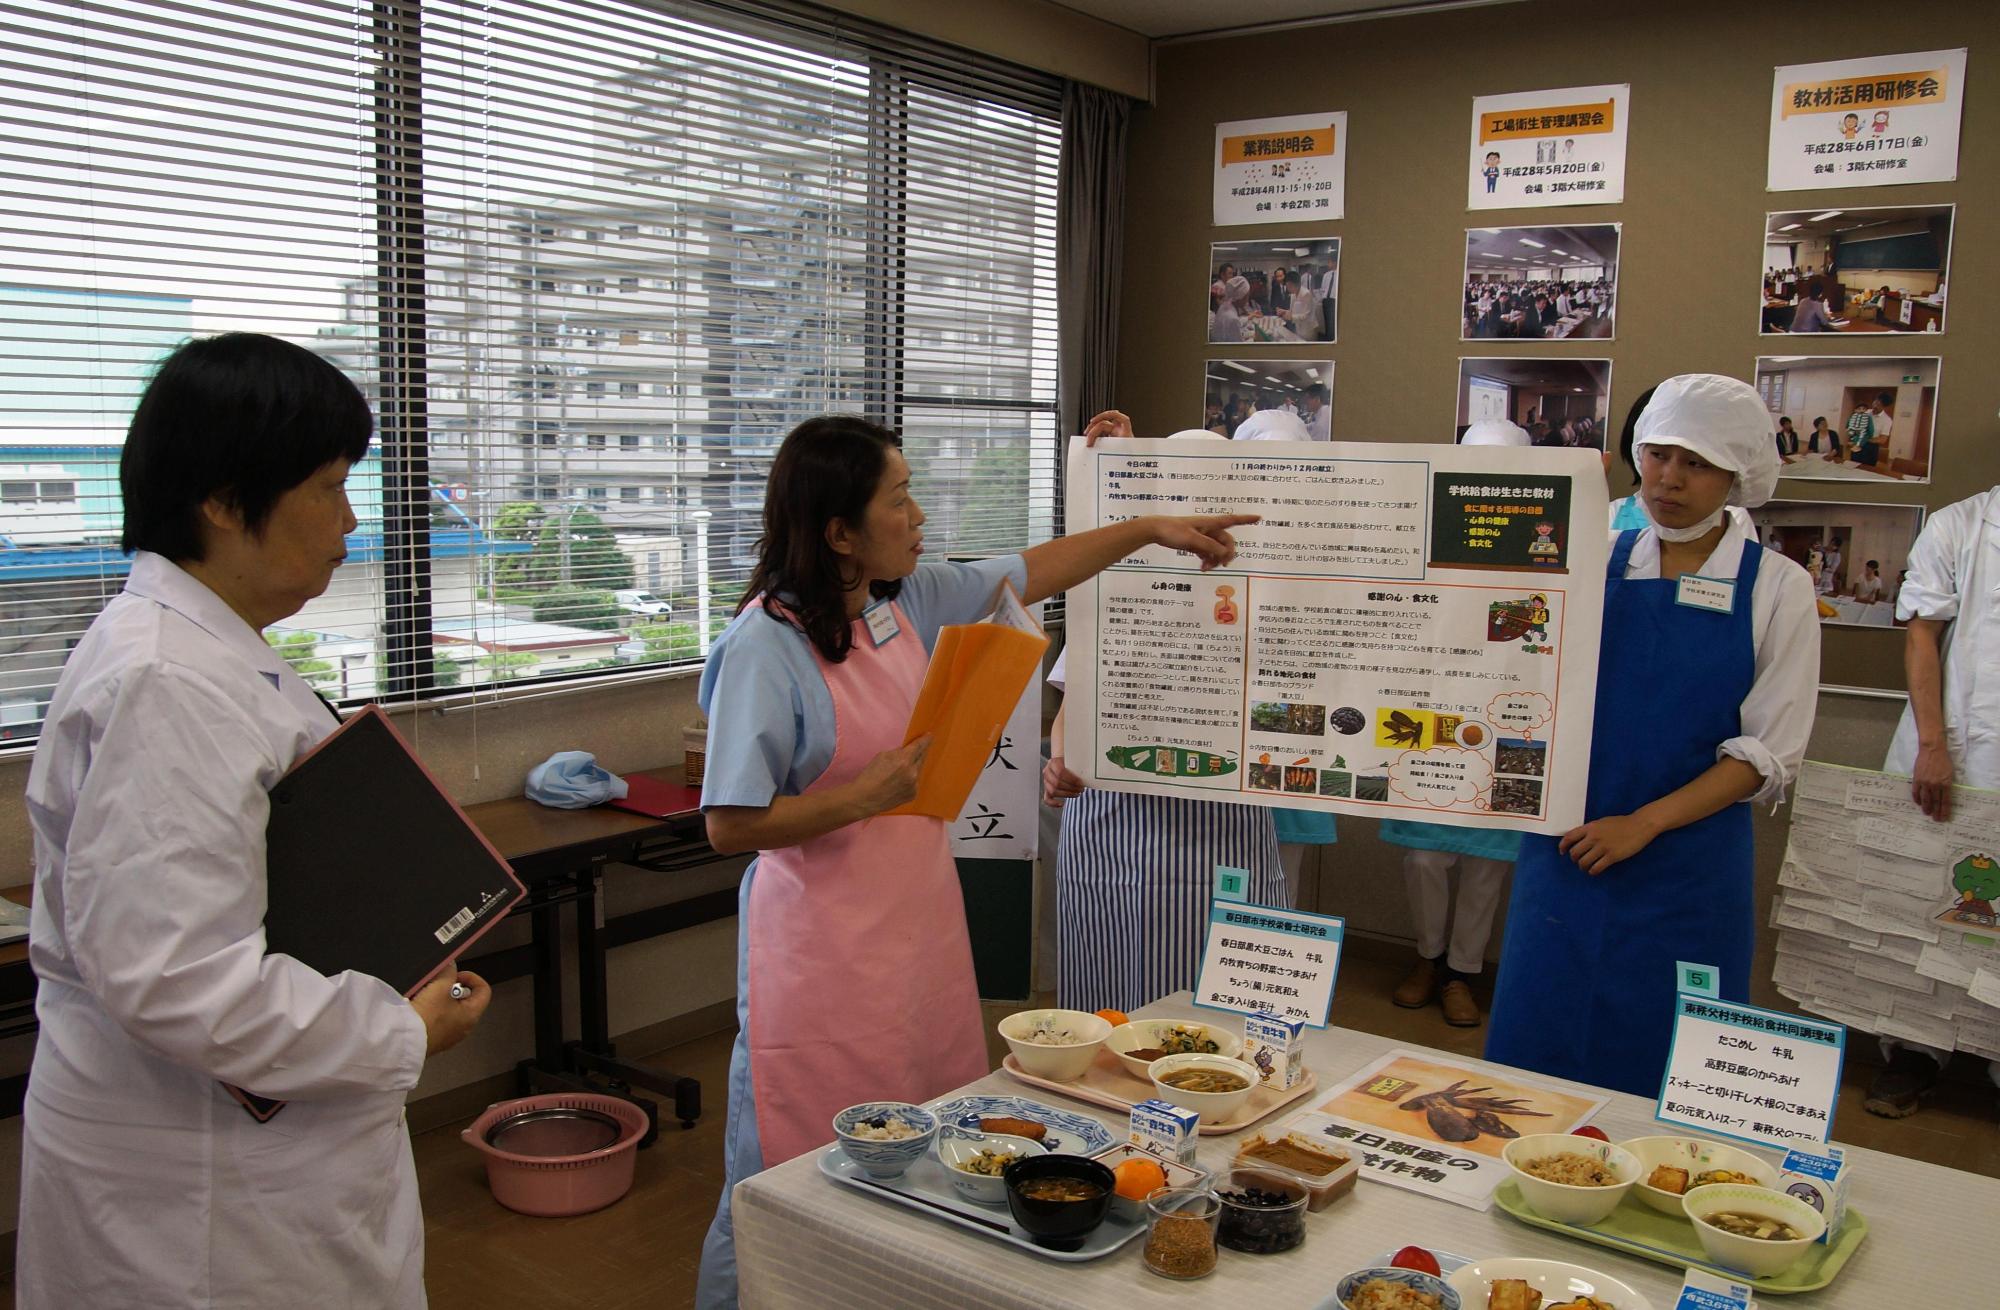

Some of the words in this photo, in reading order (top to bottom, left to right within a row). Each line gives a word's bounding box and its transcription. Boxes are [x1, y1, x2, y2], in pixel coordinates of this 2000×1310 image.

[1793, 77, 1939, 108] 教材活用研修会
[1491, 112, 1605, 133] 工場衛生管理講習会
[1243, 136, 1315, 157] 業務説明会
[1804, 135, 1928, 155] 平成28年6月17日(金)
[1502, 161, 1606, 178] 平成28年5月20日(金)
[1448, 485, 1554, 499] 学校給食は生きた教材
[1152, 581, 1192, 593] 心身の健康
[1367, 592, 1439, 604] 感謝の心・食文化
[1258, 668, 1317, 680] 誇れる地元の食材
[1227, 878, 1233, 890] 1
[1225, 912, 1327, 937] 春日部市学校栄養士研究会
[1221, 938, 1294, 958] 春日部黒大豆ごはん
[1305, 952, 1323, 964] 牛乳
[1219, 957, 1317, 981] 内牧育ちの野菜さつまあげ
[1691, 973, 1703, 986] 5
[1210, 992, 1275, 1013] 金ごま入り金平汁
[1285, 1006, 1311, 1019] みかん
[1684, 1003, 1836, 1043] 東秩父村学校給食共同調理場
[1718, 1035, 1758, 1051] たこめし
[1772, 1046, 1794, 1060] 牛乳
[1705, 1058, 1801, 1088] 高野豆腐のからあげ
[1668, 1076, 1828, 1121] ズッキーニと切り干し大根のごまあえ
[1323, 1124, 1479, 1171] 春日部産の
